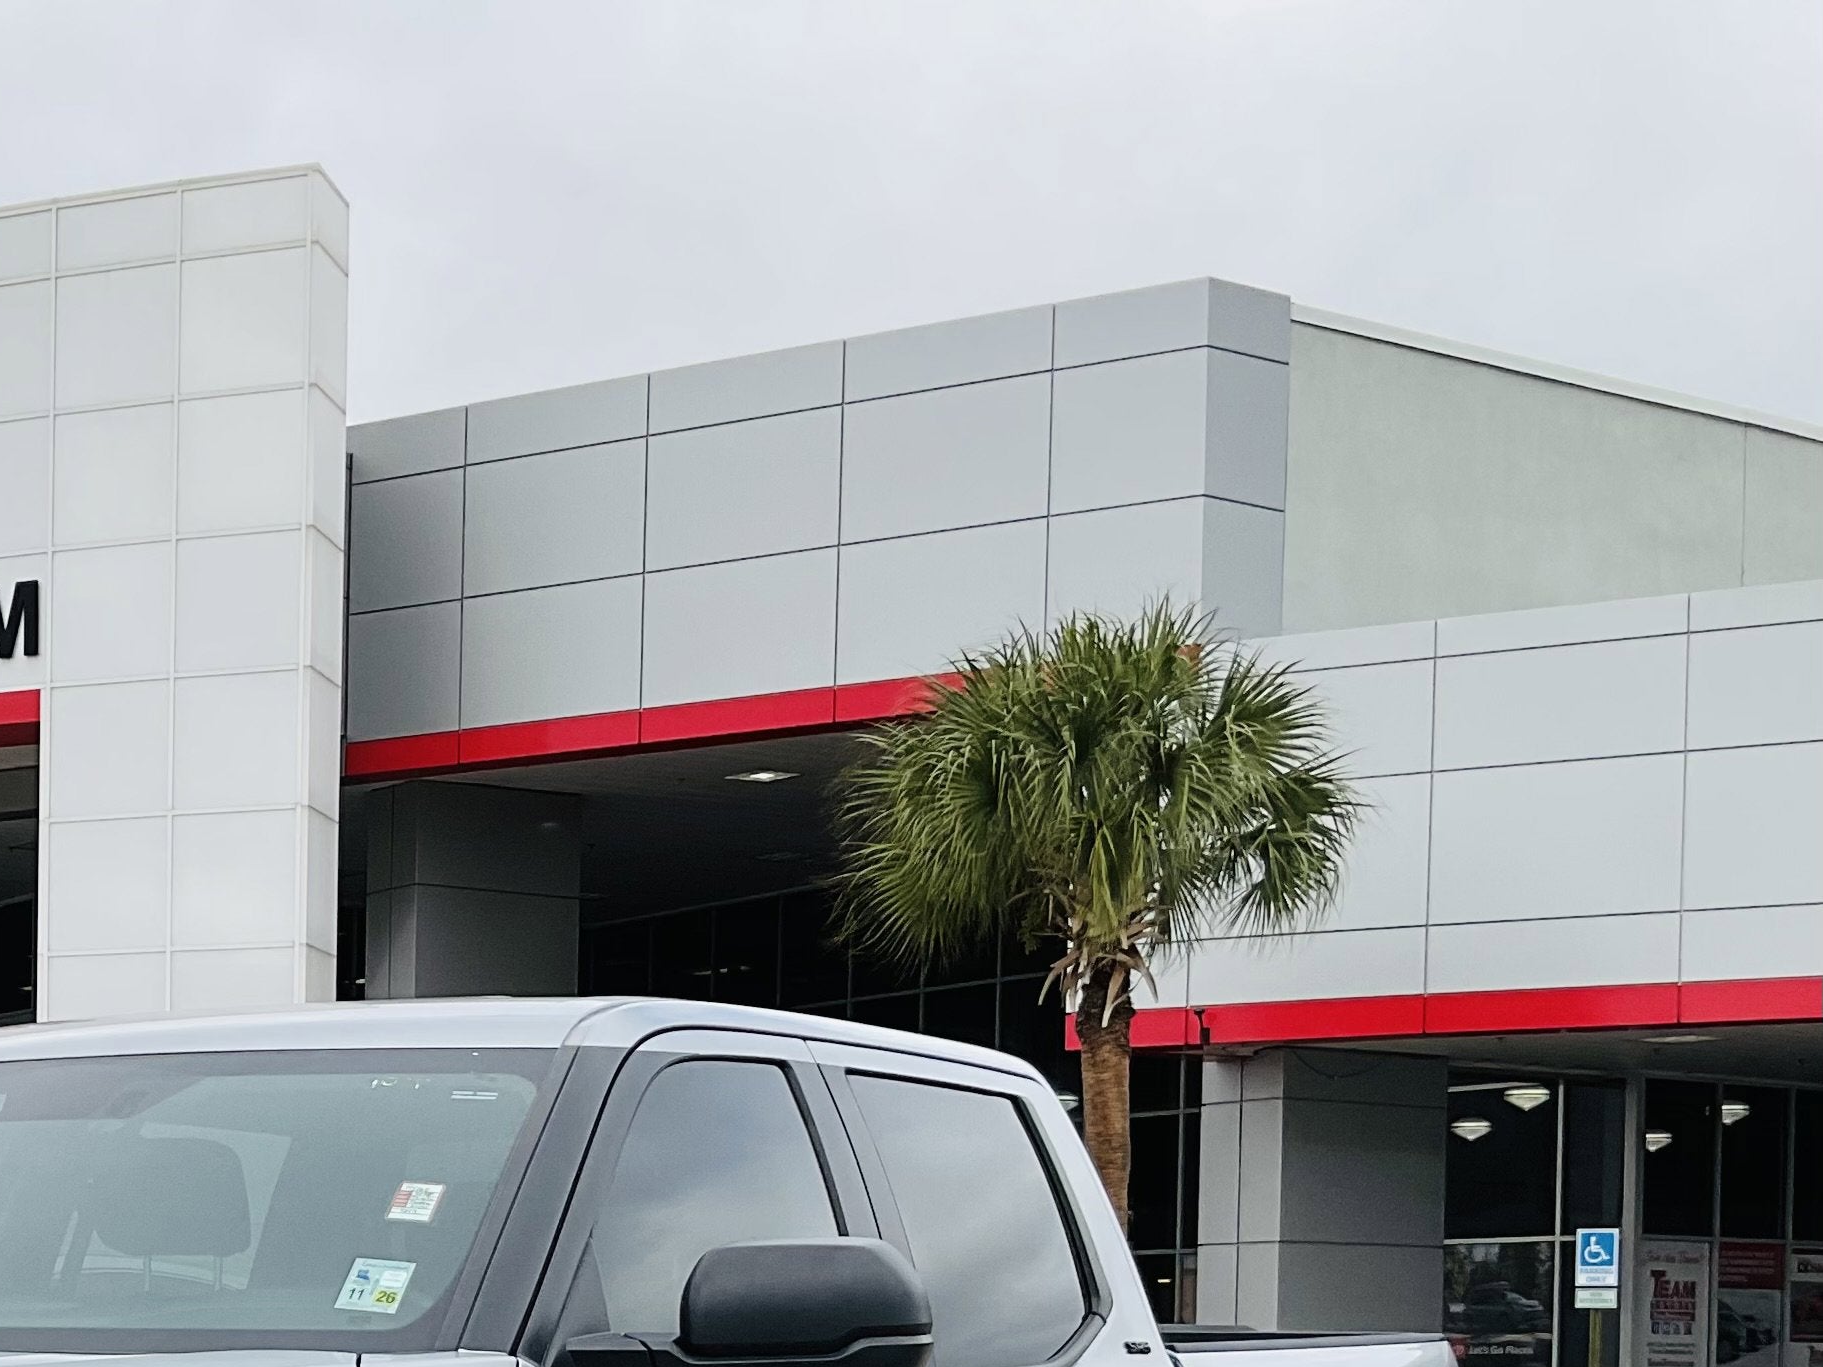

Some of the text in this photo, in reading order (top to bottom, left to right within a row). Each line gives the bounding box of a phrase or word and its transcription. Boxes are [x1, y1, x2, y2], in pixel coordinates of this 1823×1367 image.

[1650, 1269, 1697, 1298] TEAM
[348, 1287, 366, 1301] 11
[375, 1290, 397, 1304] 26
